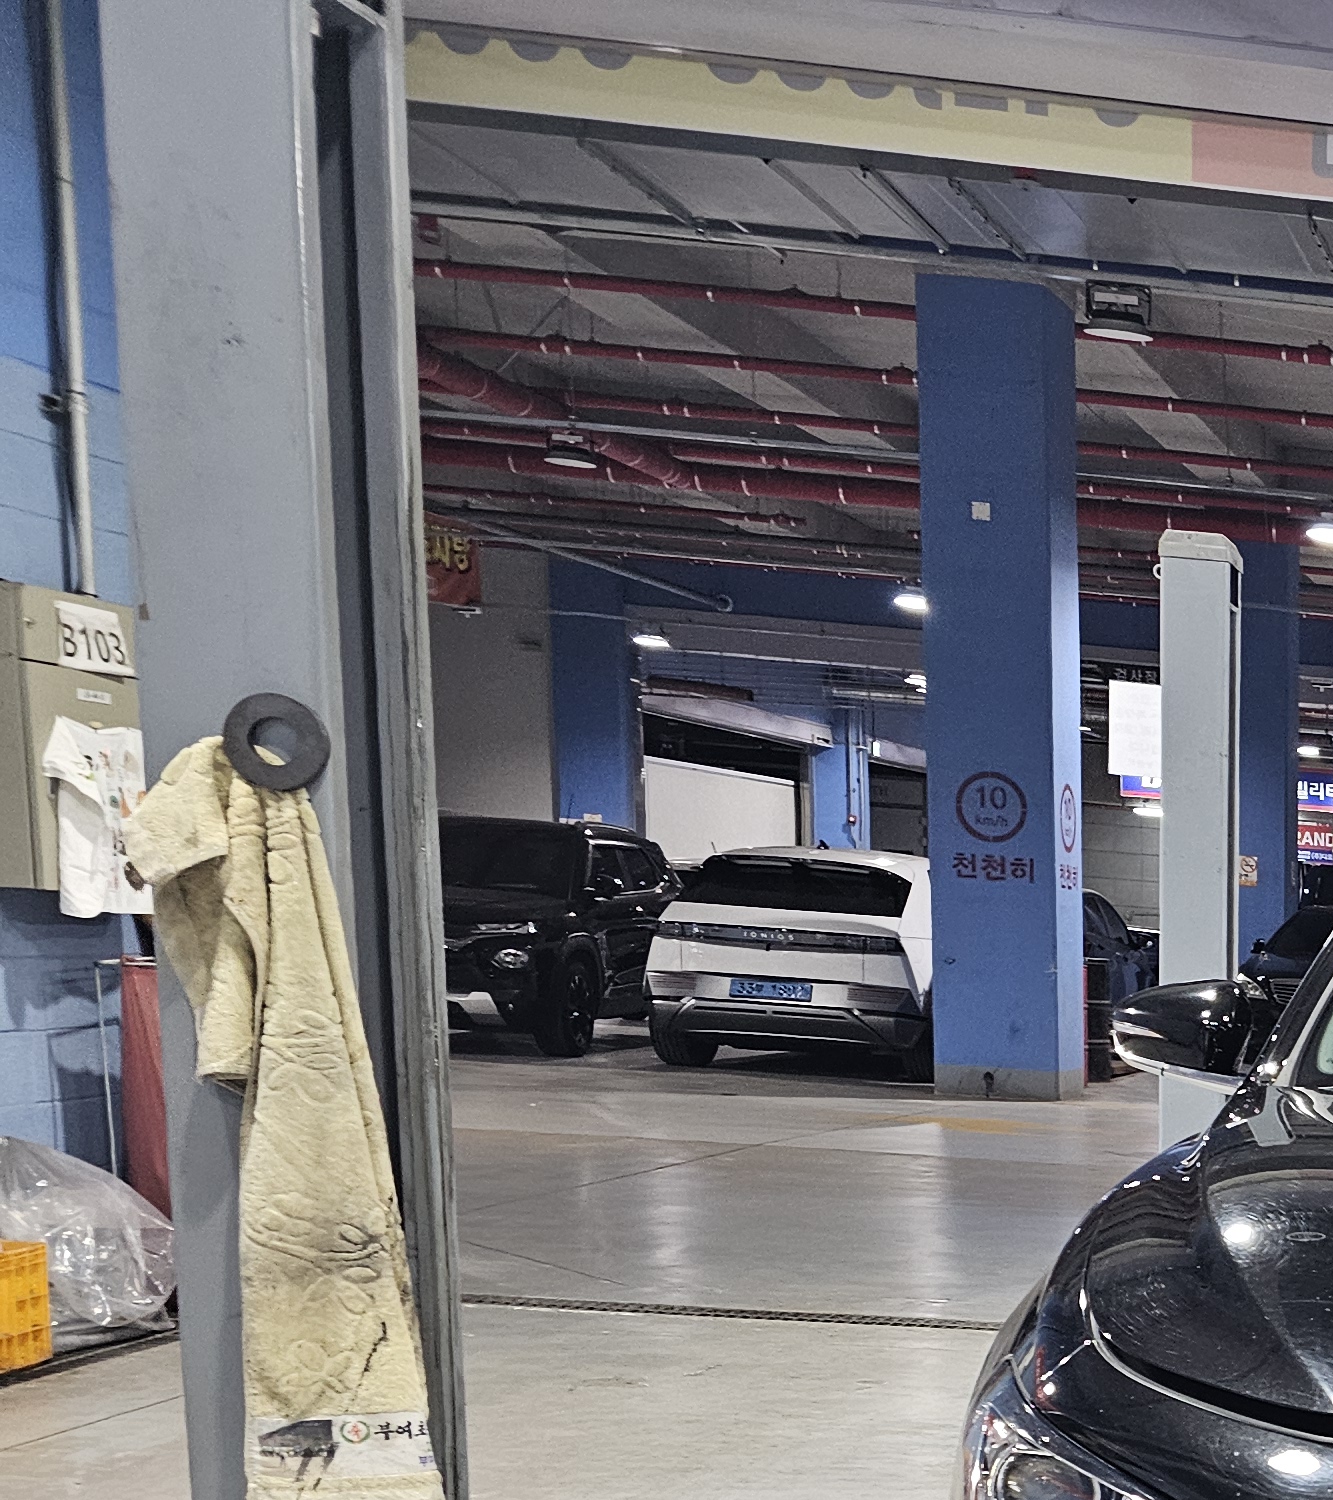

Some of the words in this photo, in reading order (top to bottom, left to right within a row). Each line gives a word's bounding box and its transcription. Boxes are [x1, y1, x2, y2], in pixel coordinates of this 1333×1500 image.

[59, 621, 127, 666] B103
[976, 786, 1007, 810] 10
[975, 814, 1008, 827] km/h
[952, 851, 1035, 884] 천천히
